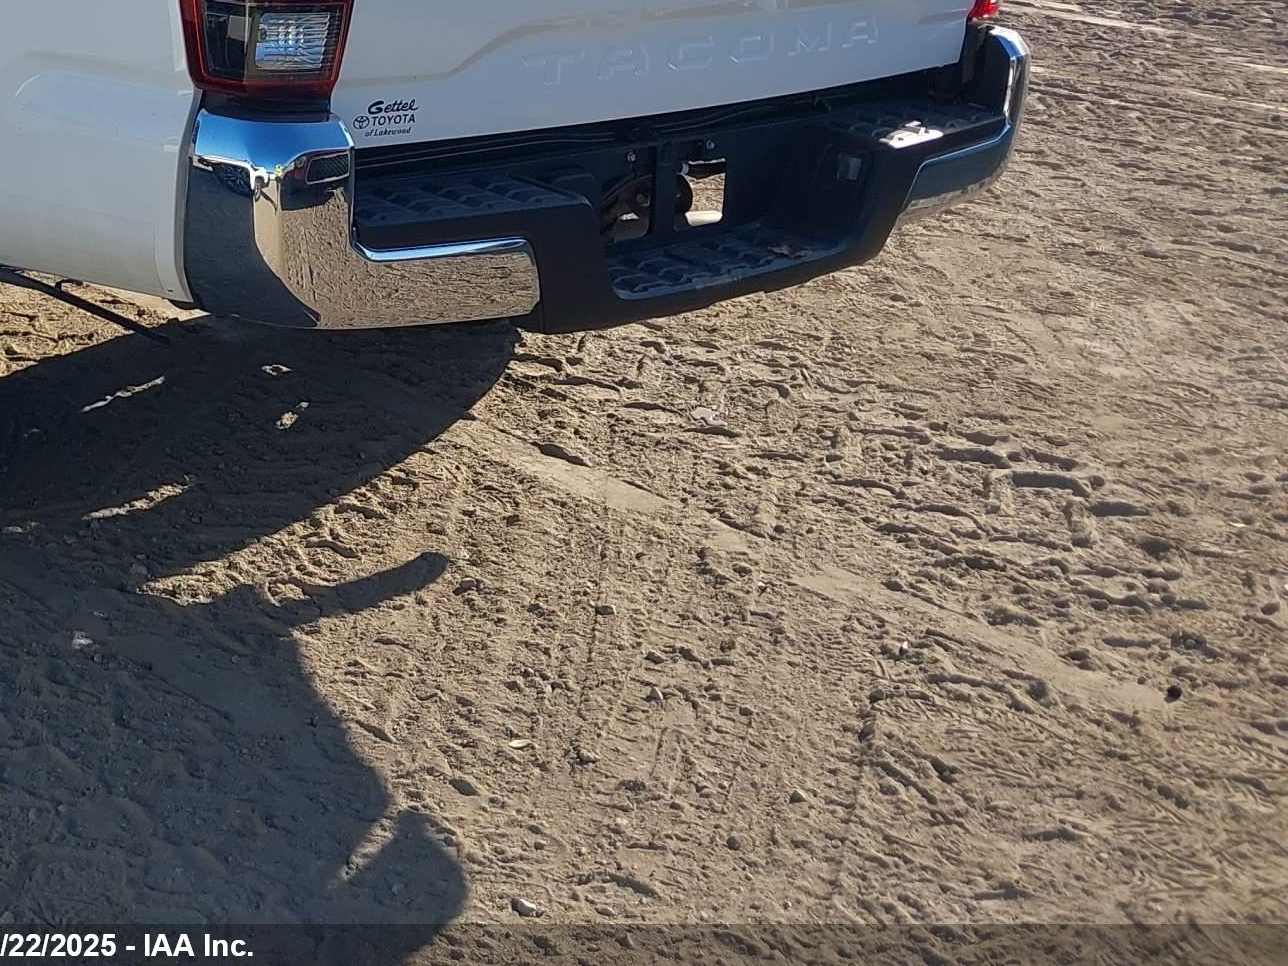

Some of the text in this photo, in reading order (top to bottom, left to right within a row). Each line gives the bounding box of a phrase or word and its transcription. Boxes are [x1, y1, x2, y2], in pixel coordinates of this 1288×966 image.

[520, 15, 880, 85] TACOMA
[368, 98, 419, 115] Gettel
[371, 114, 415, 126] TOYOTA
[374, 126, 412, 137] Lakewood
